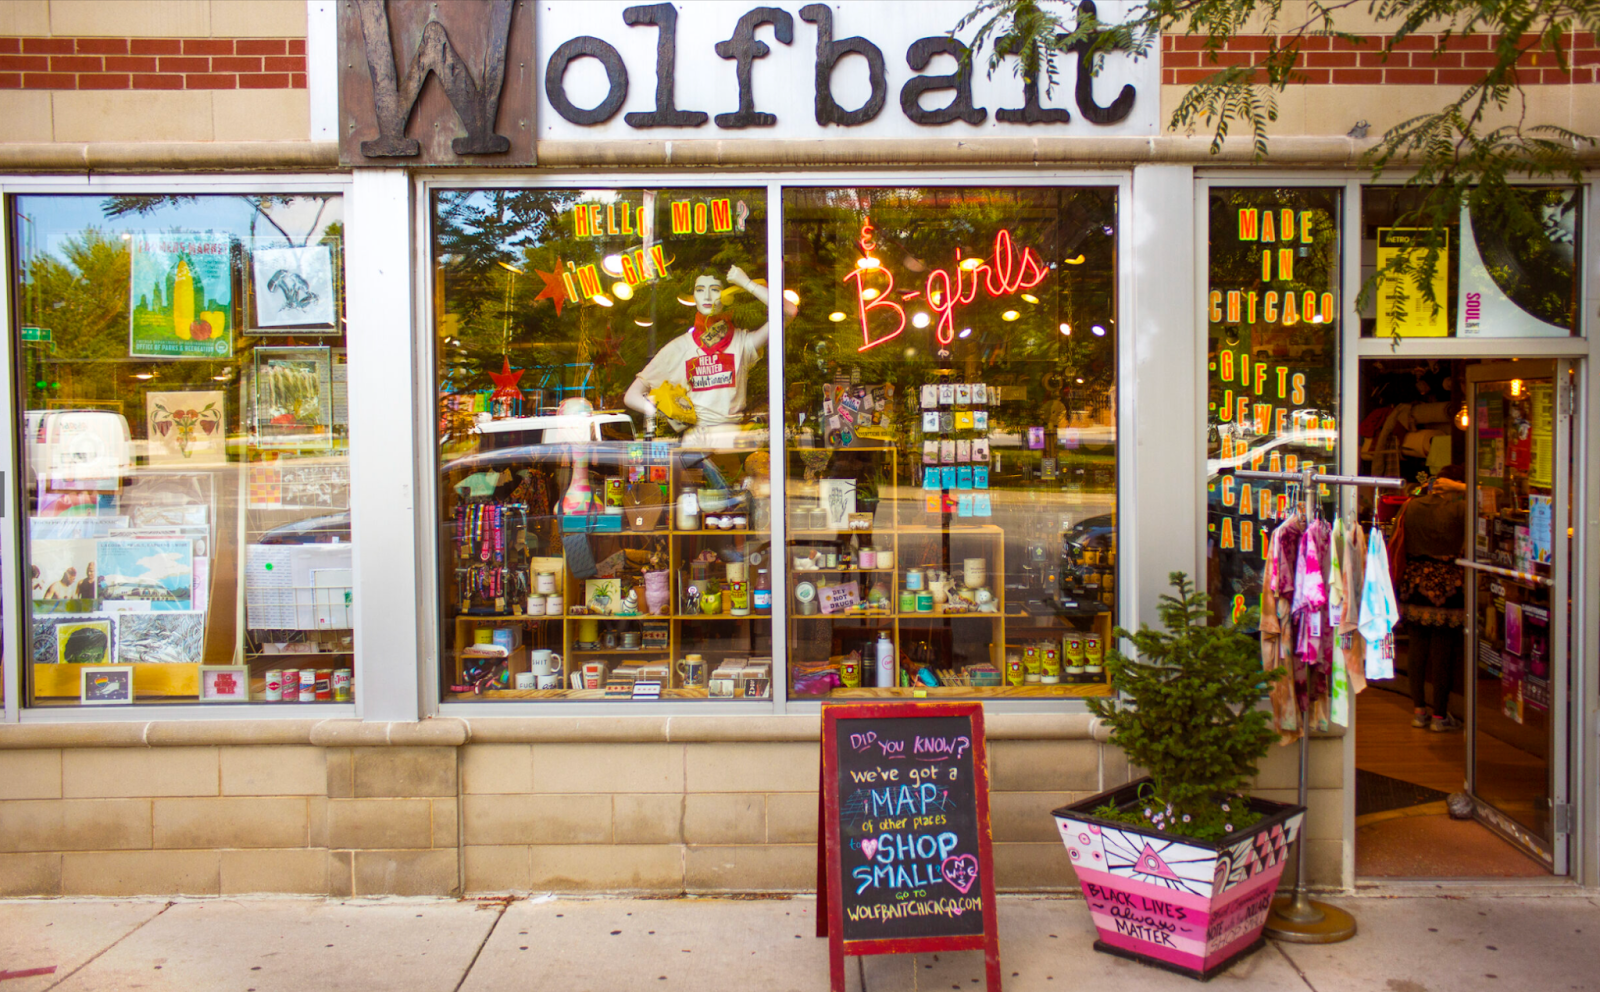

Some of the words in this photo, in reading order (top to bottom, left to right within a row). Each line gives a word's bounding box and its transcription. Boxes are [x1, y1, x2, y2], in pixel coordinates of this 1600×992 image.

[352, 0, 1137, 158] Wolfbait
[574, 202, 651, 238] HELLO
[1238, 208, 1314, 244] MADE
[563, 260, 604, 304] I'M
[621, 244, 668, 287] GAY
[1262, 248, 1294, 282] IN
[843, 228, 1050, 353] B-girls
[1209, 290, 1334, 324] CHICAGO
[1465, 292, 1481, 323] SOUL
[695, 364, 723, 376] WANTED
[699, 354, 718, 366] HELP
[1220, 350, 1306, 405] GIFTS
[1219, 389, 1336, 451] JEWELRY
[850, 731, 877, 750] DID
[878, 739, 904, 756] YOU
[914, 735, 970, 760] KNOW?
[909, 765, 939, 788] got
[949, 767, 958, 781] a
[871, 783, 938, 817] MAP
[862, 819, 875, 834] of
[879, 817, 907, 831] other
[913, 813, 948, 829] places
[876, 831, 958, 864] SHOP
[895, 890, 909, 900] GO
[912, 889, 927, 898] TO
[1087, 883, 1137, 909] BLACK
[1142, 897, 1187, 920] LIVES
[1110, 905, 1176, 933] always
[1115, 918, 1177, 949] MATTER
